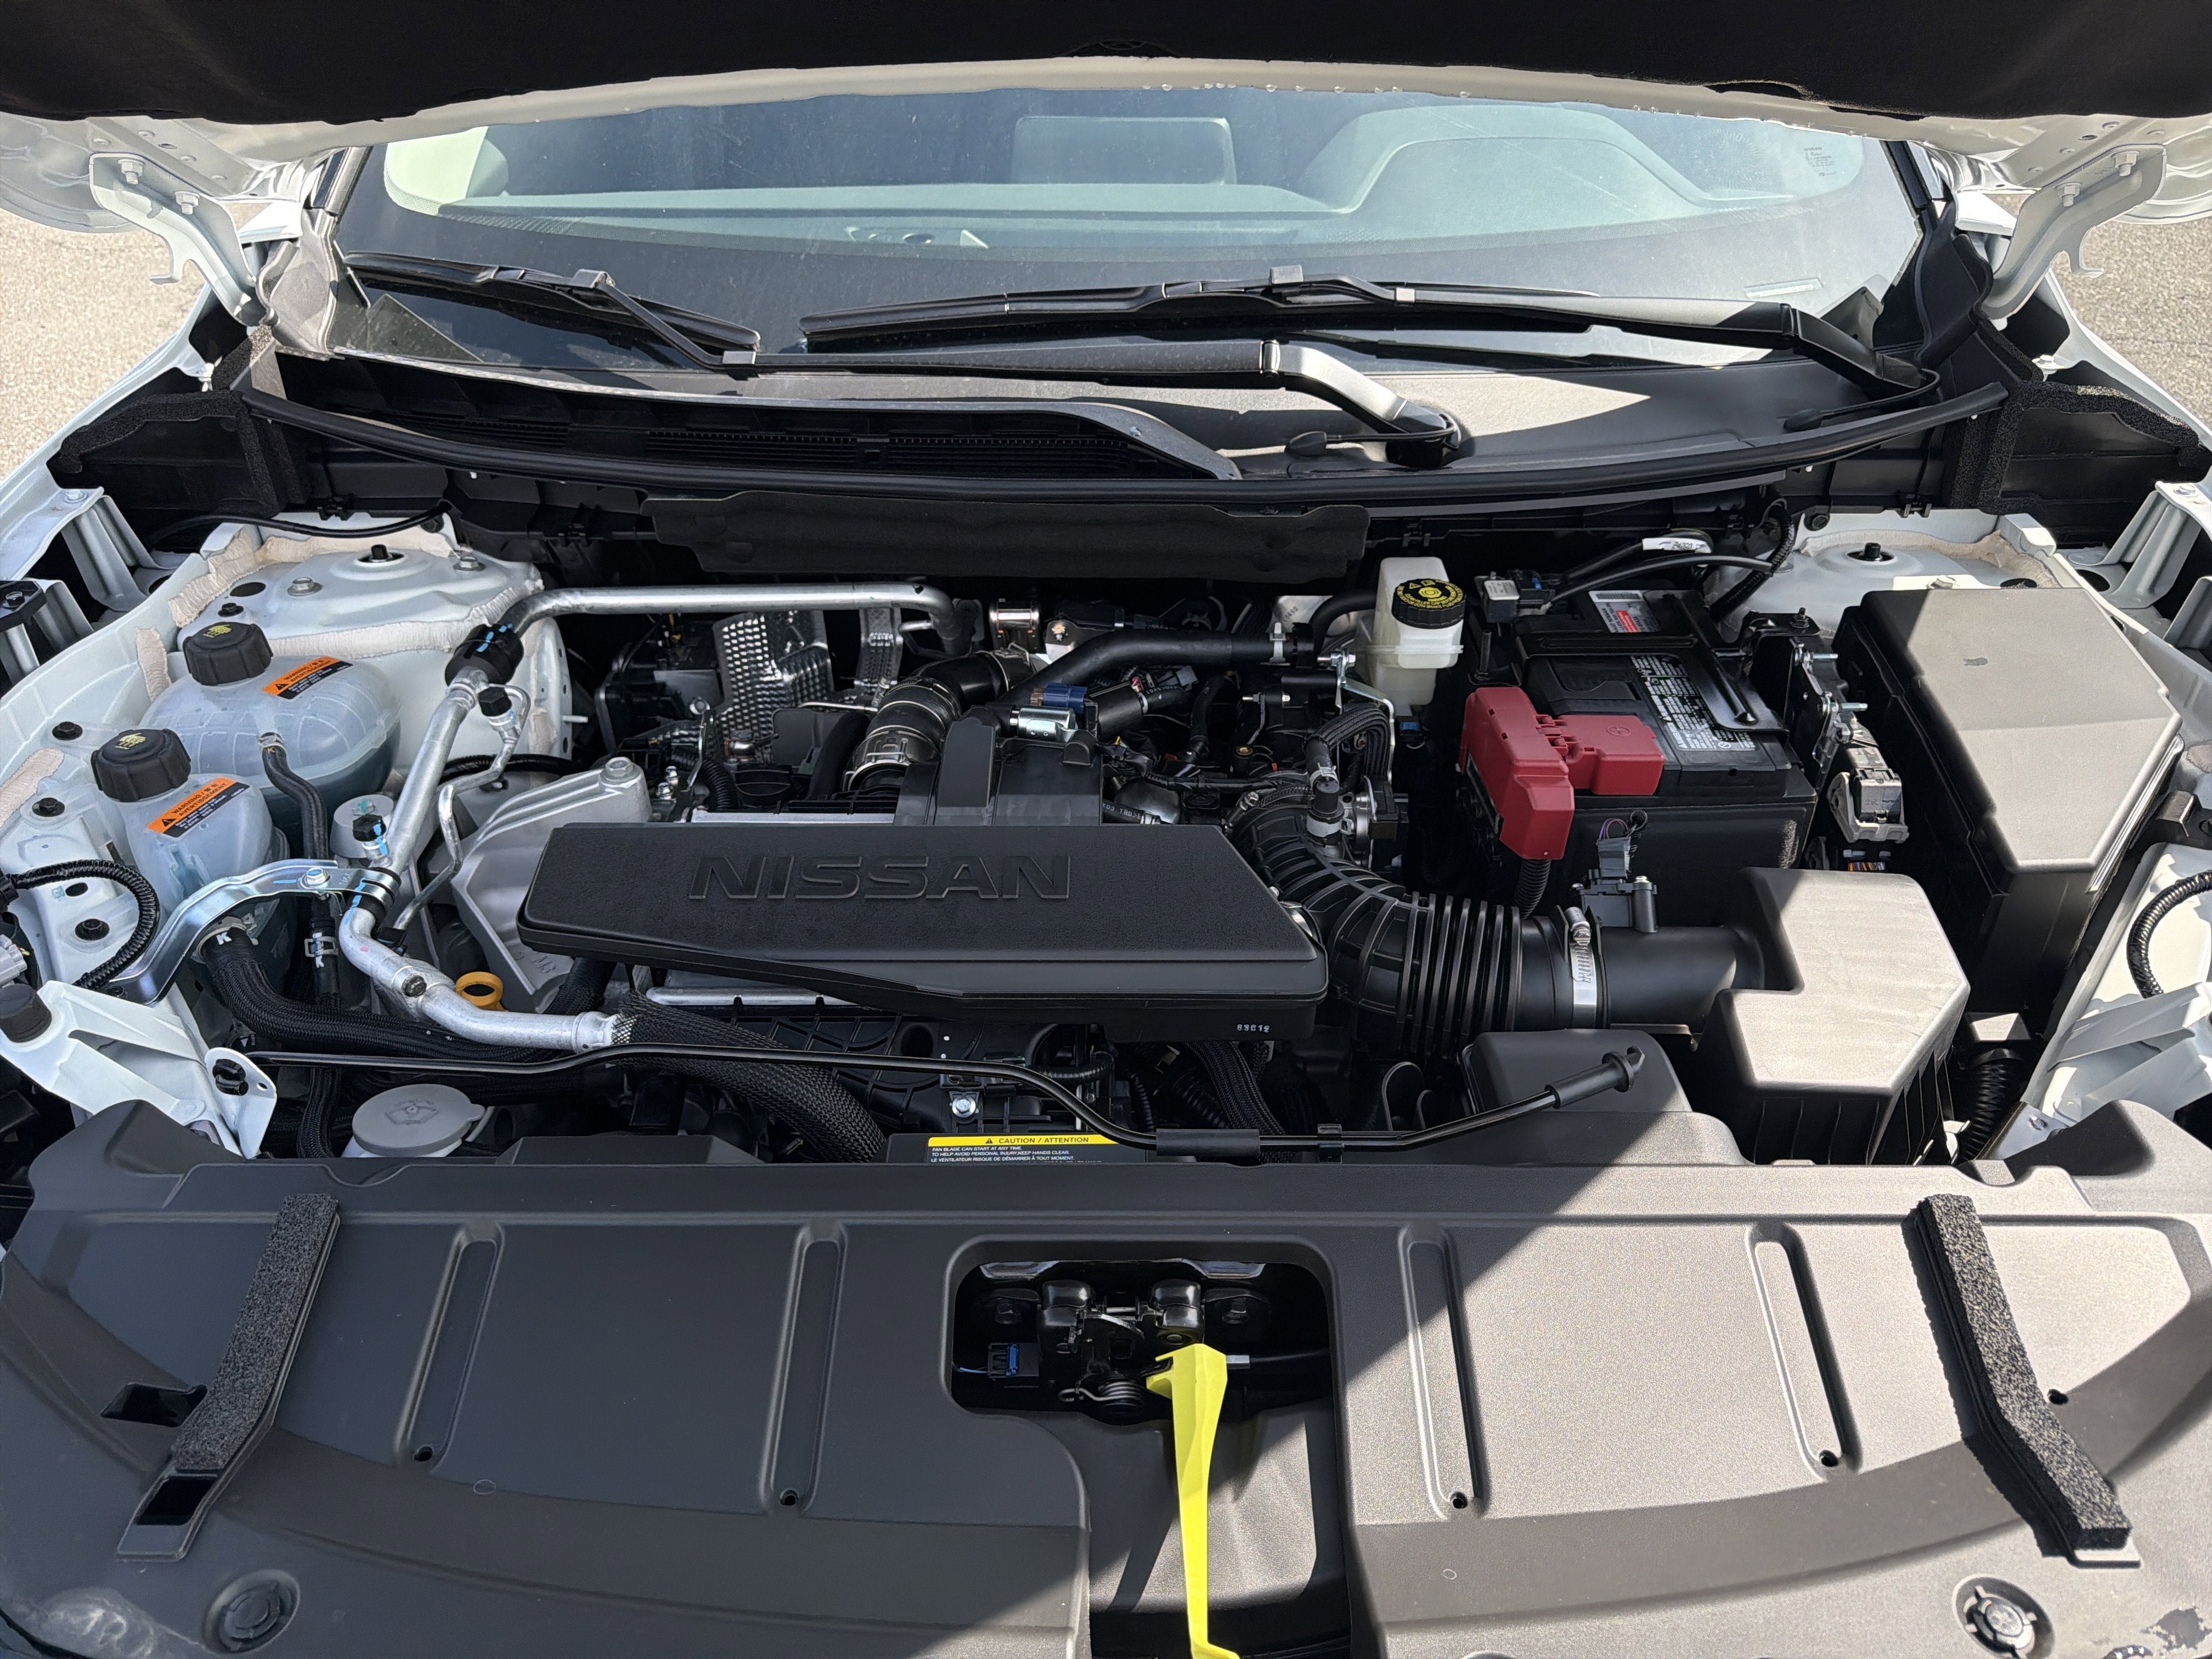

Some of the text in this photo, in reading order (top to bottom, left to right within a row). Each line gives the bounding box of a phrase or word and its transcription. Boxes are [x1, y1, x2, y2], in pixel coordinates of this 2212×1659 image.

[267, 746, 276, 754] K
[172, 794, 202, 814] WARNING
[179, 783, 228, 817] AVERTISSEMENT
[688, 854, 1071, 900] NISSAN
[216, 931, 232, 945] K
